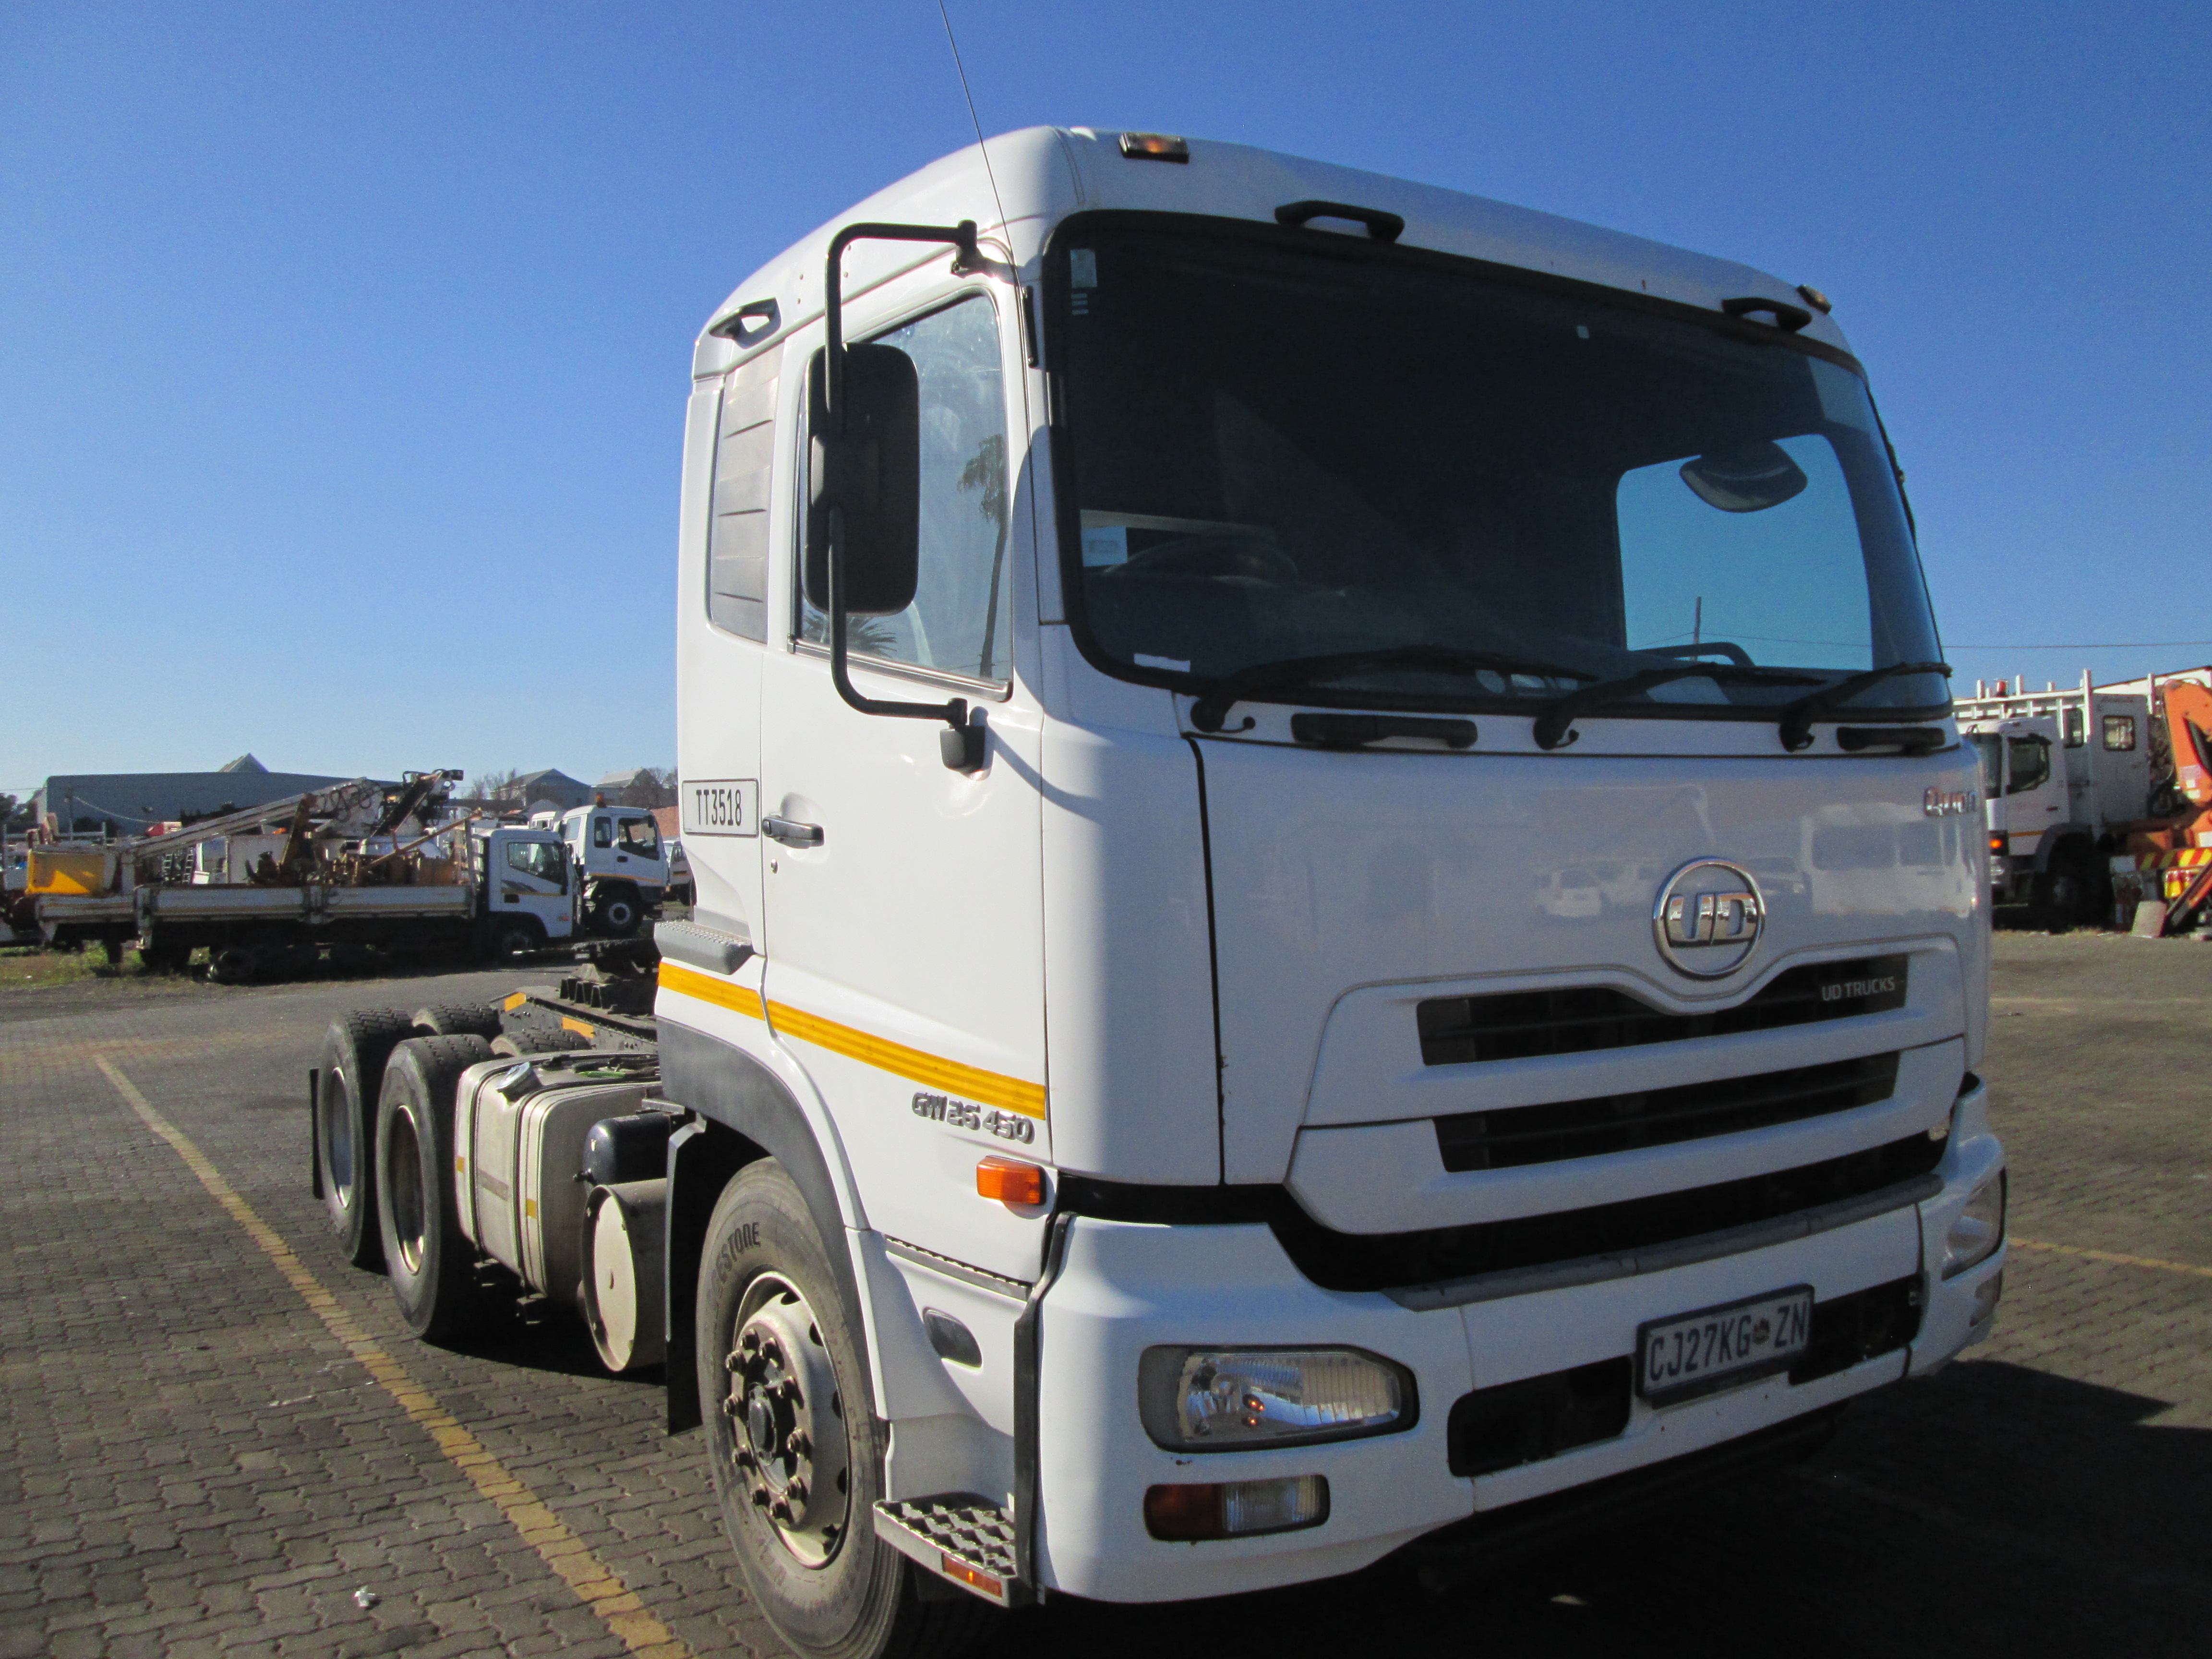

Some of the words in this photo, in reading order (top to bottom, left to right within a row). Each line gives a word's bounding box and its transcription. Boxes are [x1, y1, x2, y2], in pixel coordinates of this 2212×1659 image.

[696, 788, 742, 827] TT3518
[1664, 892, 1757, 948] UD
[1822, 985, 1842, 1001] UD
[1844, 976, 1896, 998] TRUCKS
[982, 1109, 1035, 1144] 450
[1649, 1315, 1752, 1382] CJ27KG
[1775, 1301, 1807, 1348] ZN
